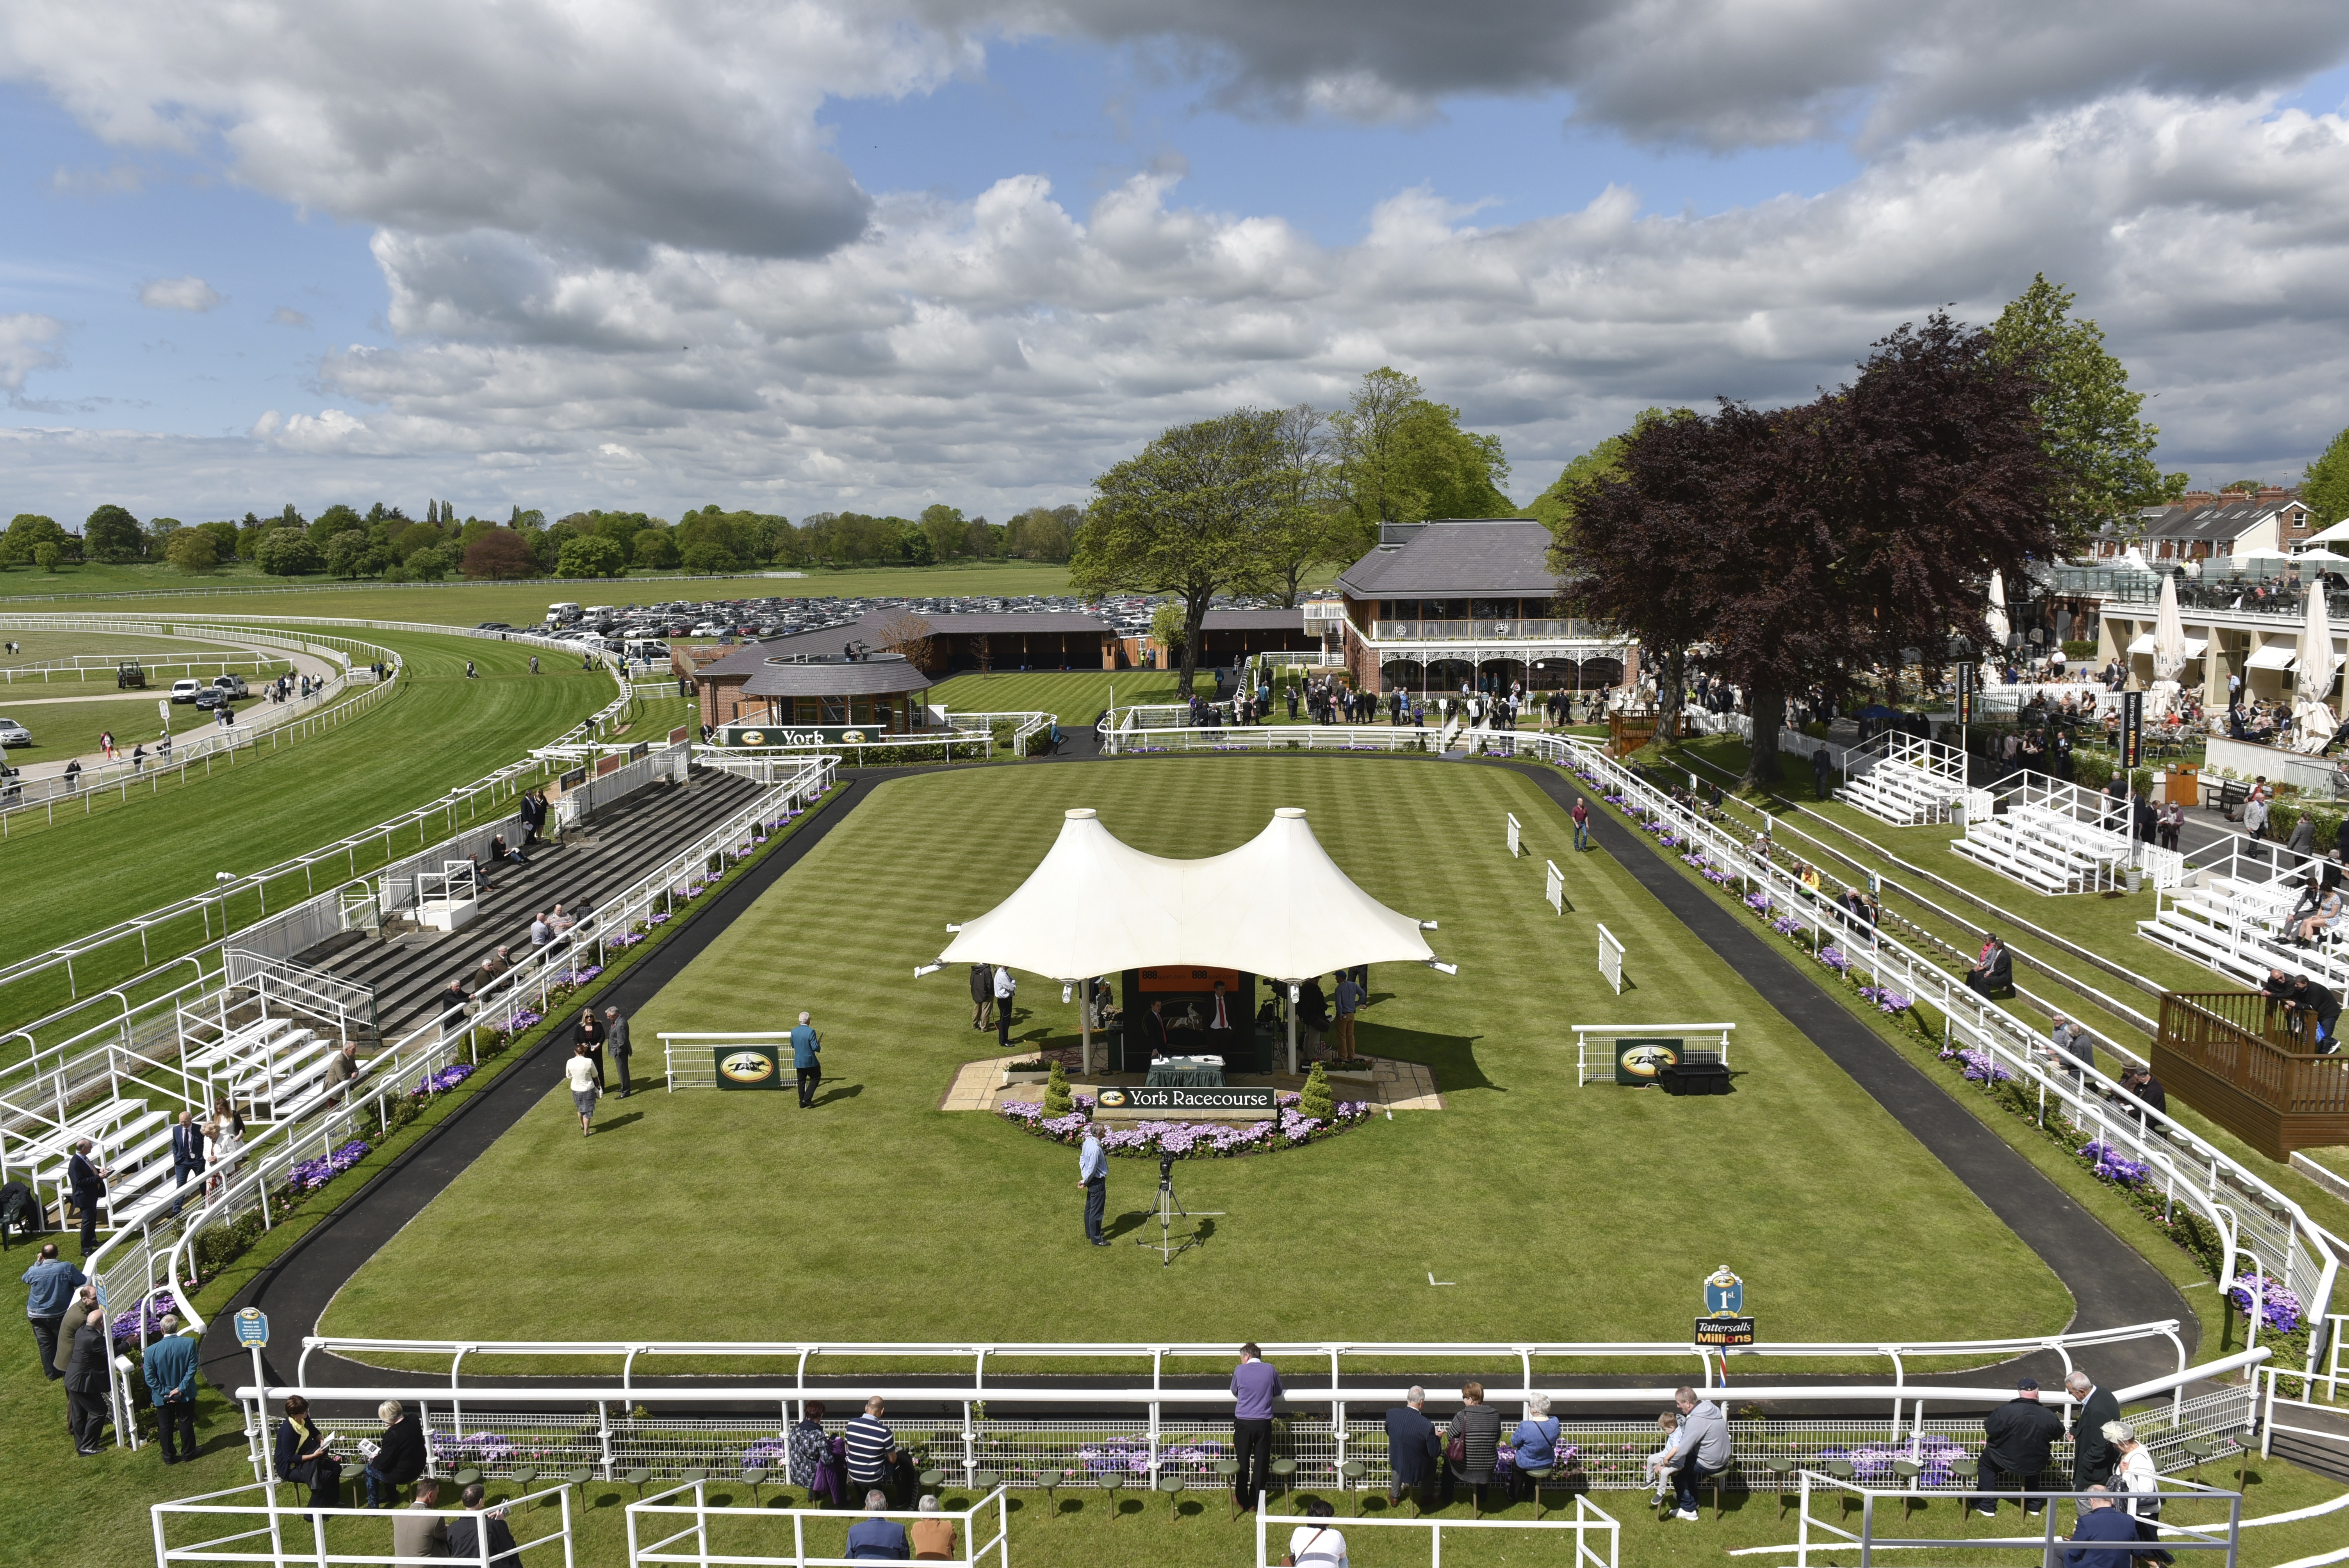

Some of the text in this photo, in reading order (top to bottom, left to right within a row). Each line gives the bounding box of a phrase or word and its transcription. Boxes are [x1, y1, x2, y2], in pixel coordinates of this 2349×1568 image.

[782, 730, 824, 745] York
[1142, 970, 1236, 980] 888sport.com 888sport.com
[1130, 1090, 1267, 1106] York Racecourse
[1720, 1291, 1735, 1309] 1st
[1699, 1322, 1751, 1332] Tattersalls
[1697, 1333, 1752, 1343] Millions
